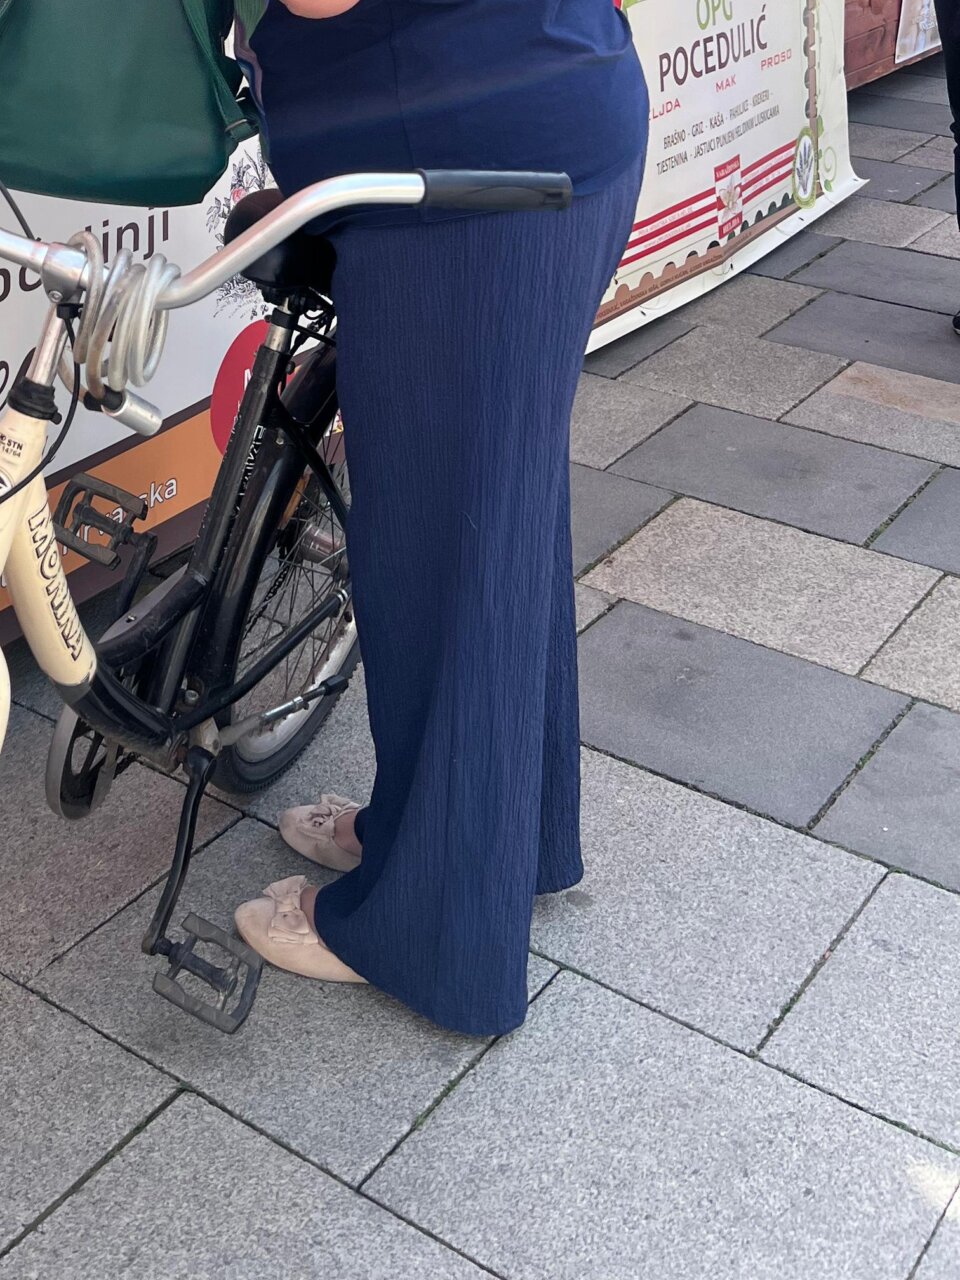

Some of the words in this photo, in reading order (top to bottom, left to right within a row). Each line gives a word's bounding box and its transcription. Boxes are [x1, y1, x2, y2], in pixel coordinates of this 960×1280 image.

[658, 4, 768, 93] POCEDULIĆ
[760, 48, 793, 71] PROSO
[715, 73, 737, 93] MAK
[649, 98, 681, 121] LJDA
[663, 129, 686, 150] BRAŠNO
[691, 122, 704, 138] GRIZ
[709, 112, 725, 130] KAŠA
[656, 150, 688, 176] TJESTENINA
[6, 440, 24, 451] STN
